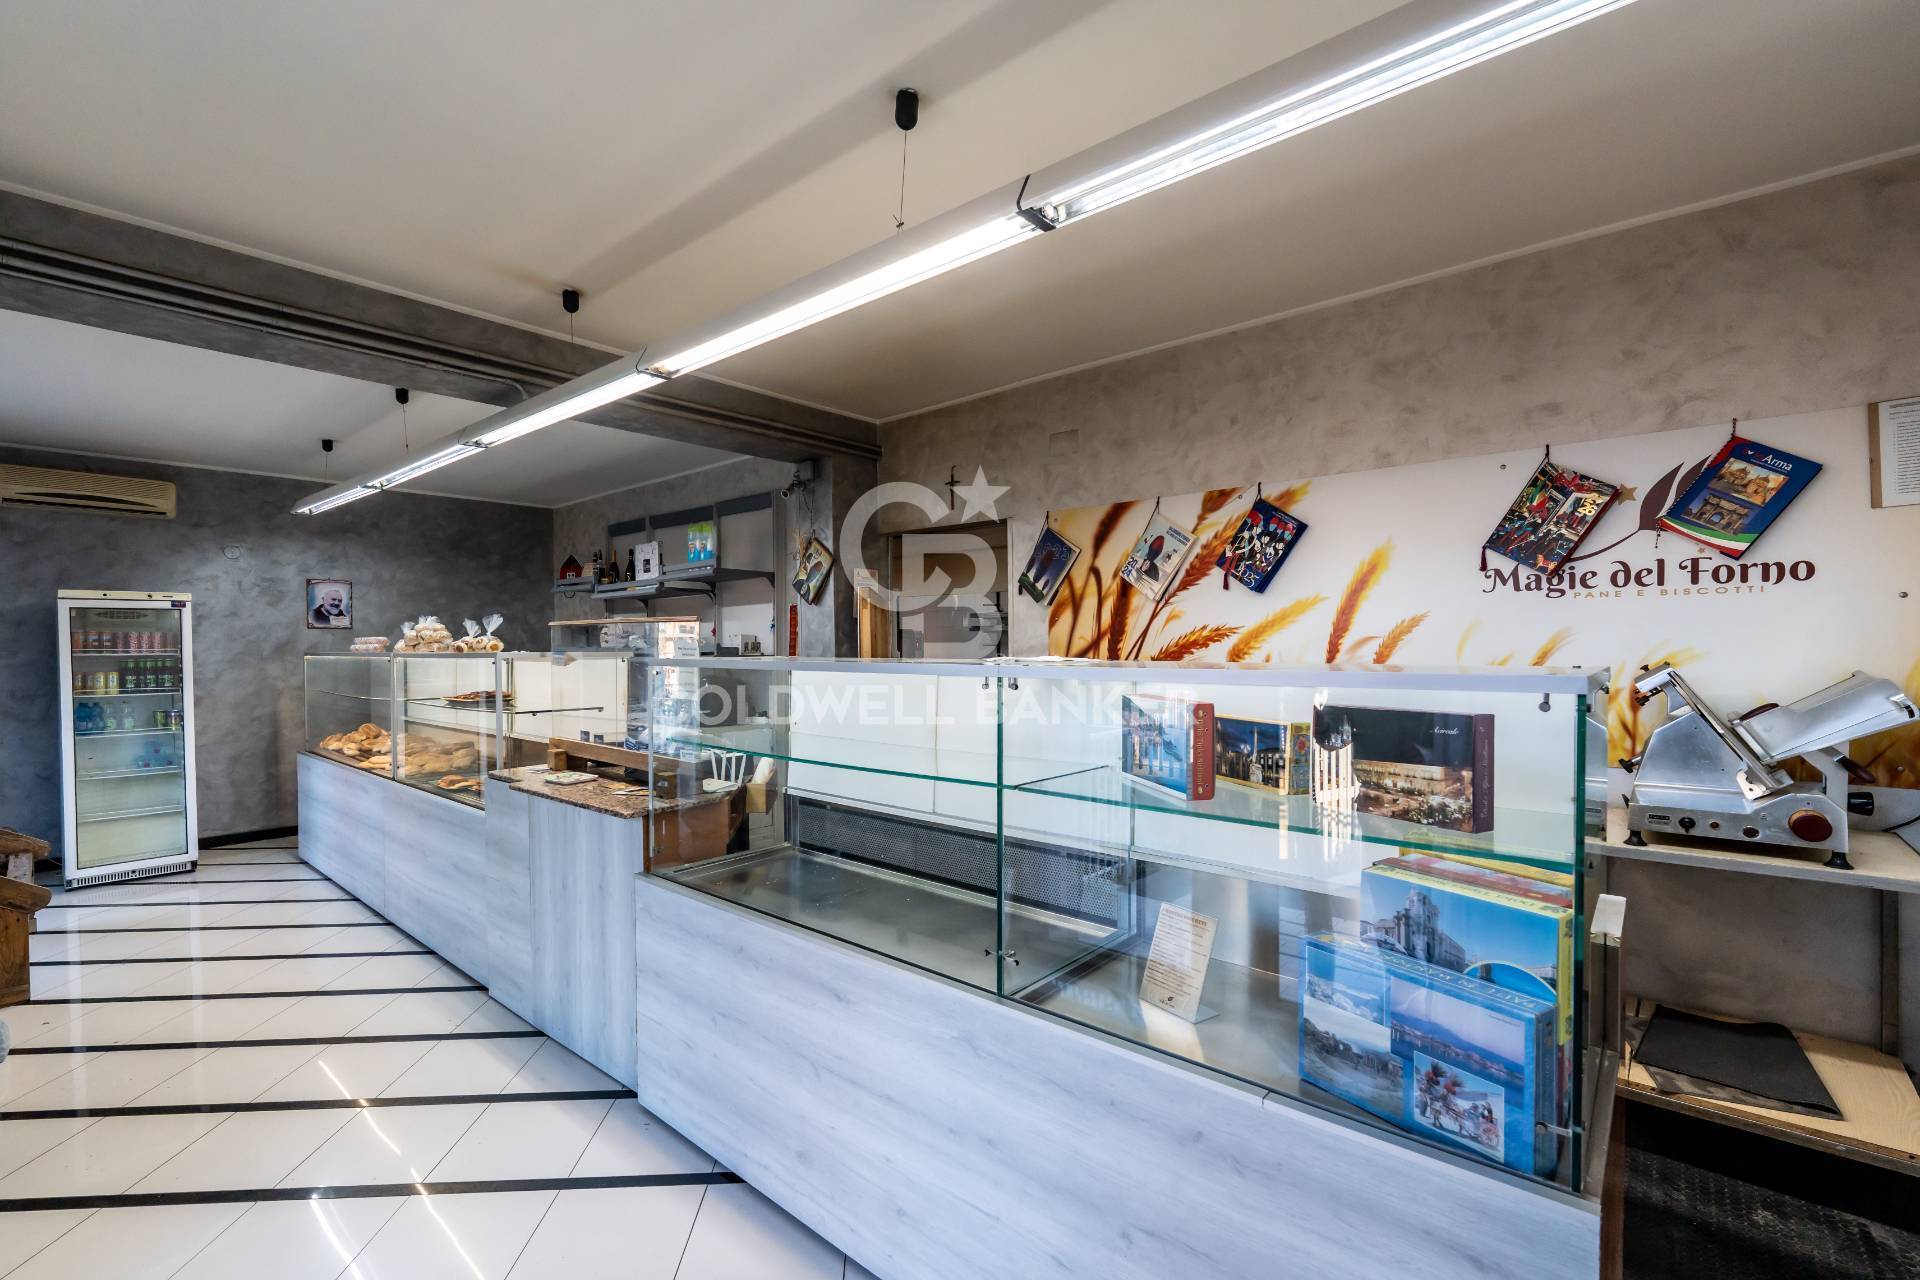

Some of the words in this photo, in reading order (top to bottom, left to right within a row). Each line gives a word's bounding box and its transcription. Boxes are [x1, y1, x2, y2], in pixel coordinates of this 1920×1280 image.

[1762, 454, 1793, 471] Arma
[1482, 563, 1599, 599] Magie
[1609, 558, 1666, 590] del
[1678, 556, 1816, 586] Forno
[1573, 590, 1623, 599] PANE
[1636, 589, 1646, 597] E
[1659, 585, 1766, 597] BISCOTTI
